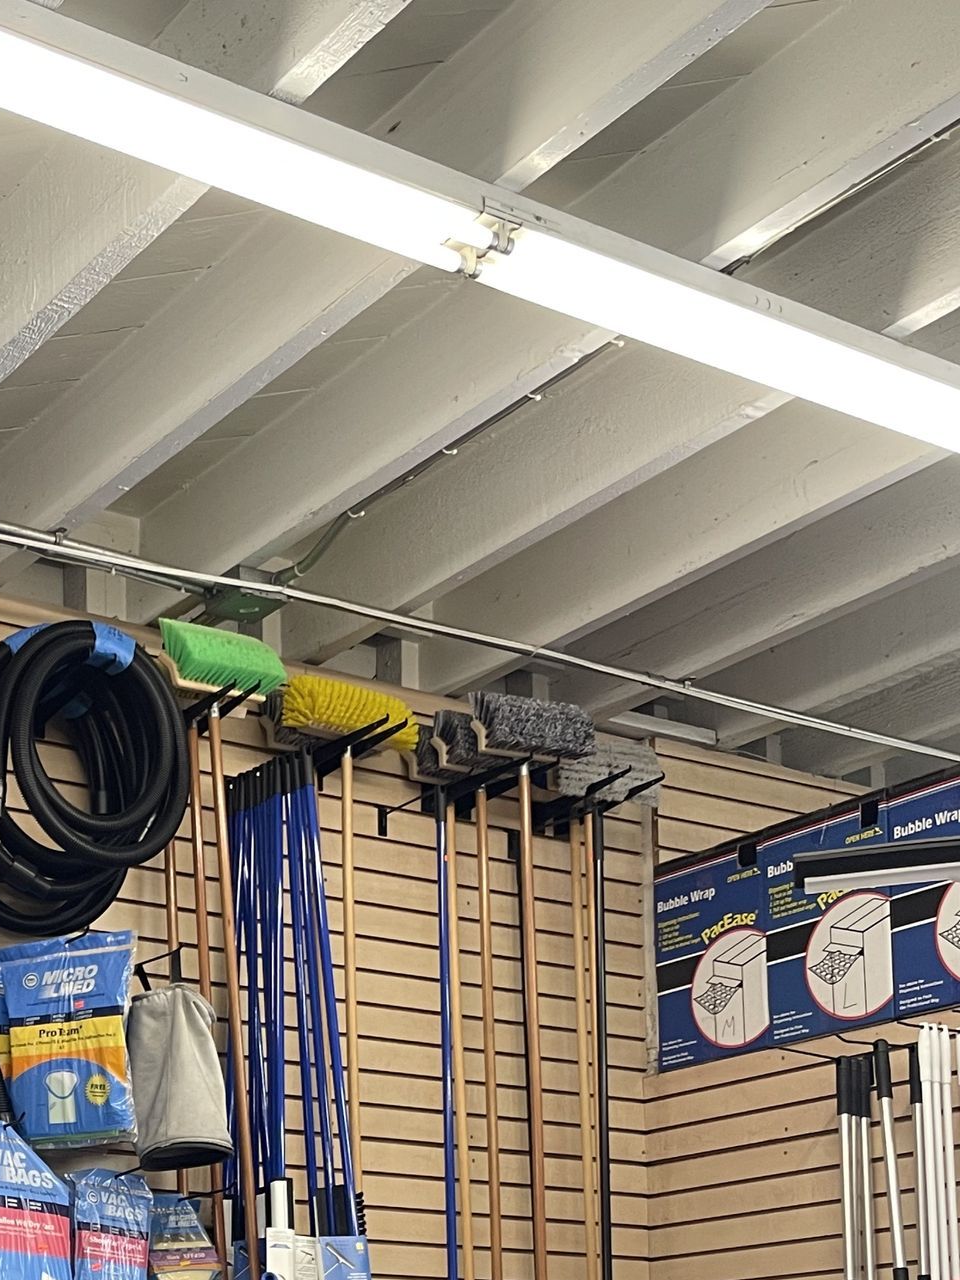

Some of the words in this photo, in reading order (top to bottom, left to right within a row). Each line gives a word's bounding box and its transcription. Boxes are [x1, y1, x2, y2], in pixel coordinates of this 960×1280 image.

[657, 896, 689, 913] Bubble
[690, 888, 716, 902] Wrap
[41, 964, 98, 985] MICRO
[90, 1082, 106, 1091] FREE
[4, 1166, 54, 1190] BAGS
